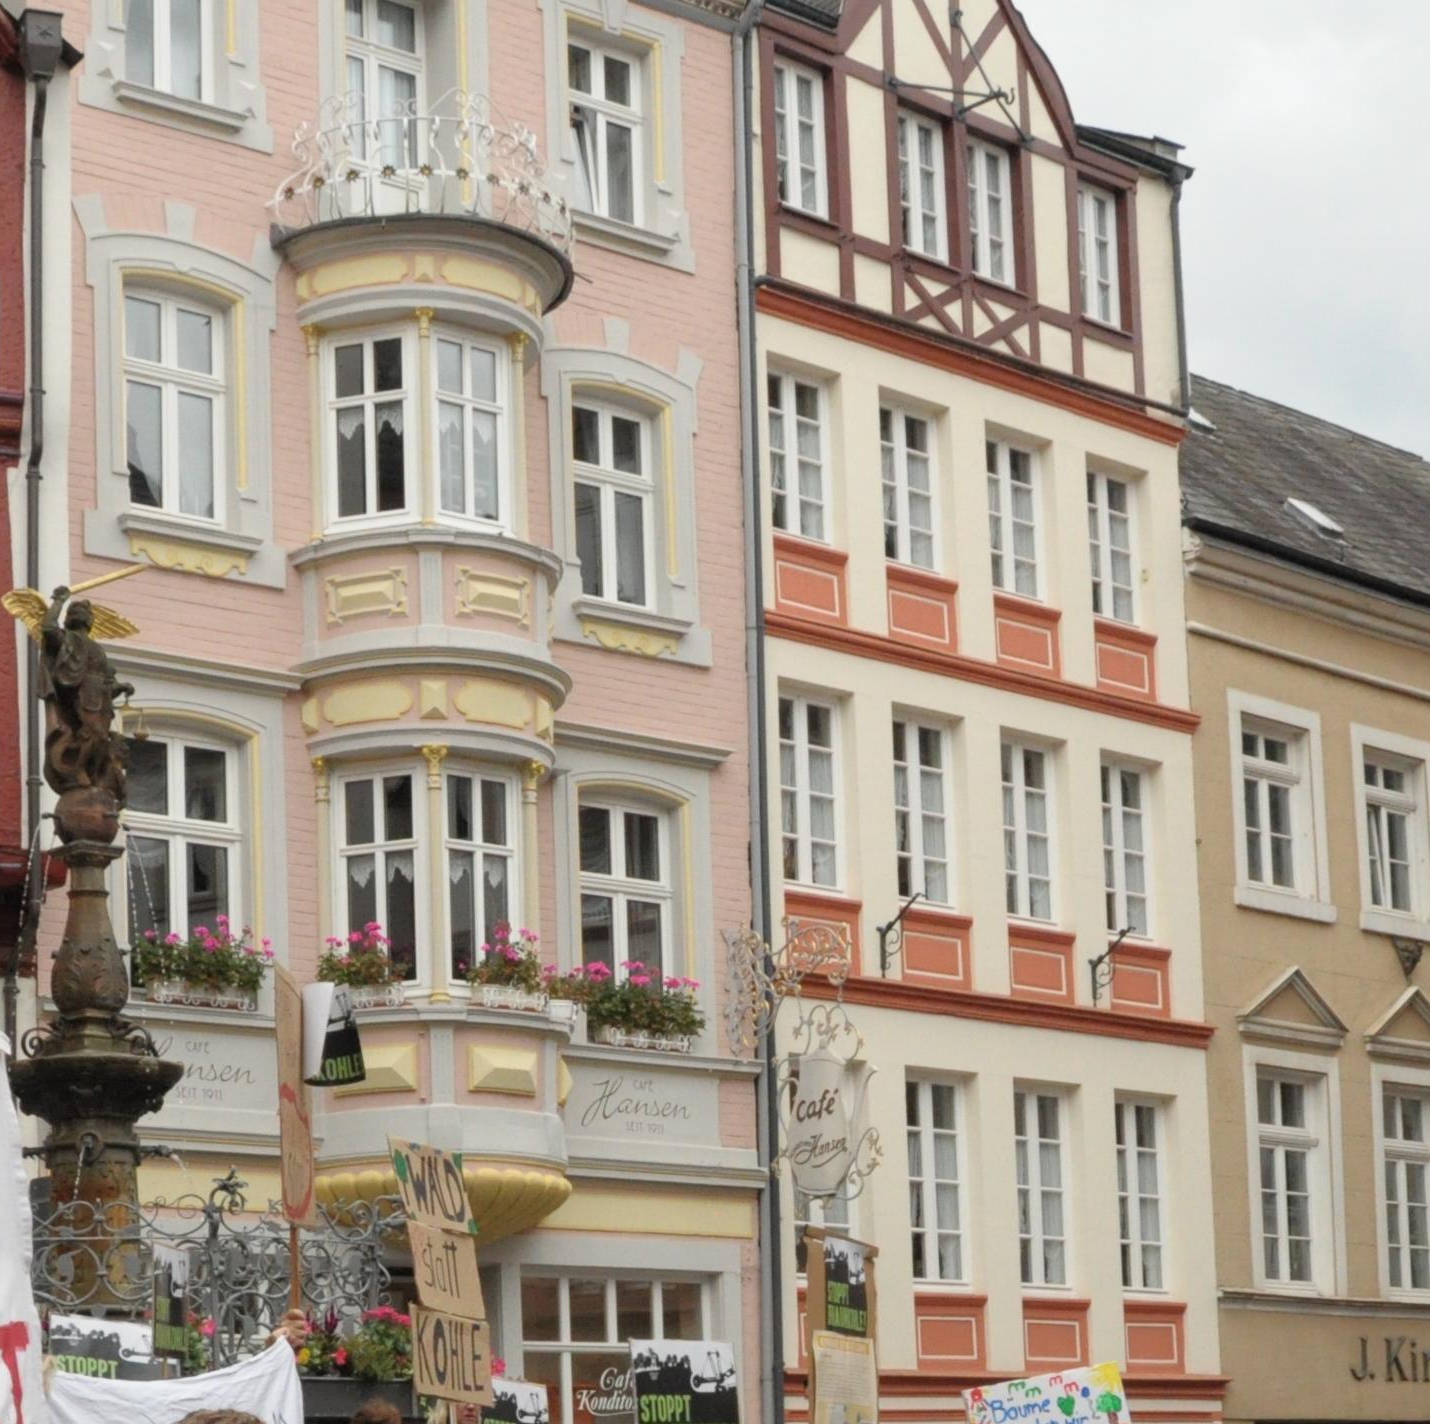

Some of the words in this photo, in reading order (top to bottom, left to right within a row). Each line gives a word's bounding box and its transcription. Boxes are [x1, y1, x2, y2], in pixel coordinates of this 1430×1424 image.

[581, 1076, 691, 1128] Hansen
[404, 1153, 466, 1224] WALD
[57, 1354, 118, 1380] STOPPT
[415, 1315, 485, 1393] KOHLE
[1349, 1336, 1376, 1382] J.
[576, 1389, 636, 1413] Kondito
[640, 1394, 692, 1423] STOPPT
